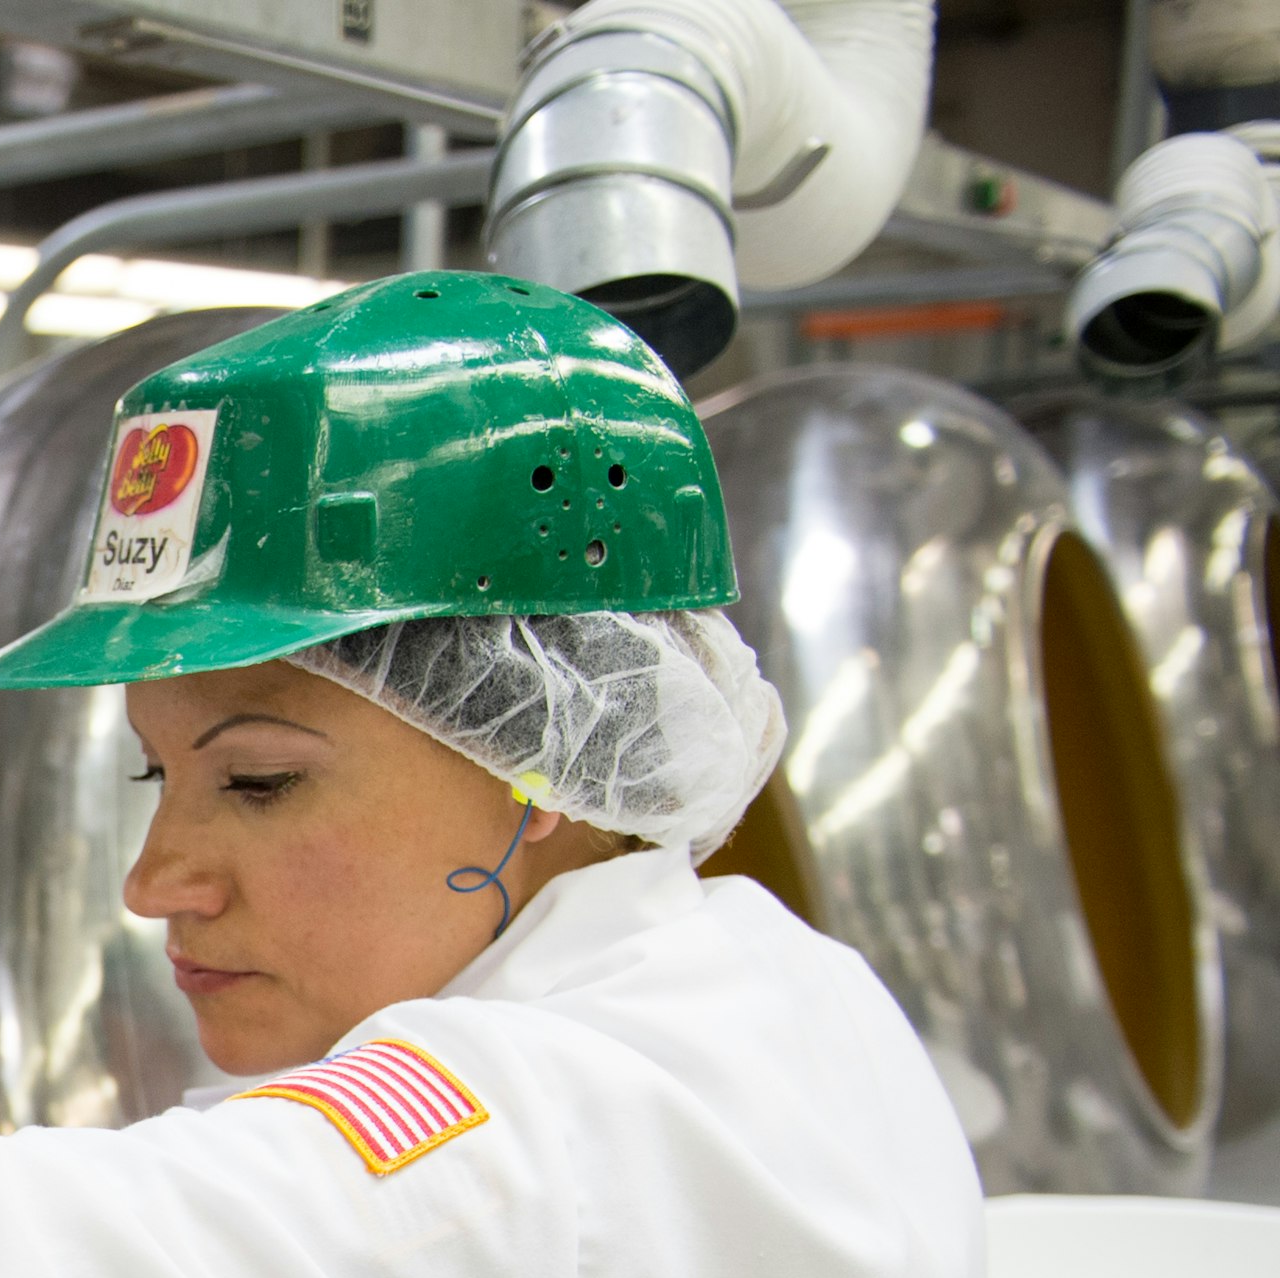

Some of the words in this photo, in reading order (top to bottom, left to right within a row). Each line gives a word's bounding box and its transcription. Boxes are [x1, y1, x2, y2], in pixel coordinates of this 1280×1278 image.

[132, 424, 171, 472] Jelly
[117, 469, 157, 514] Belly
[103, 529, 168, 574] Suzy
[112, 578, 135, 591] Diaz
